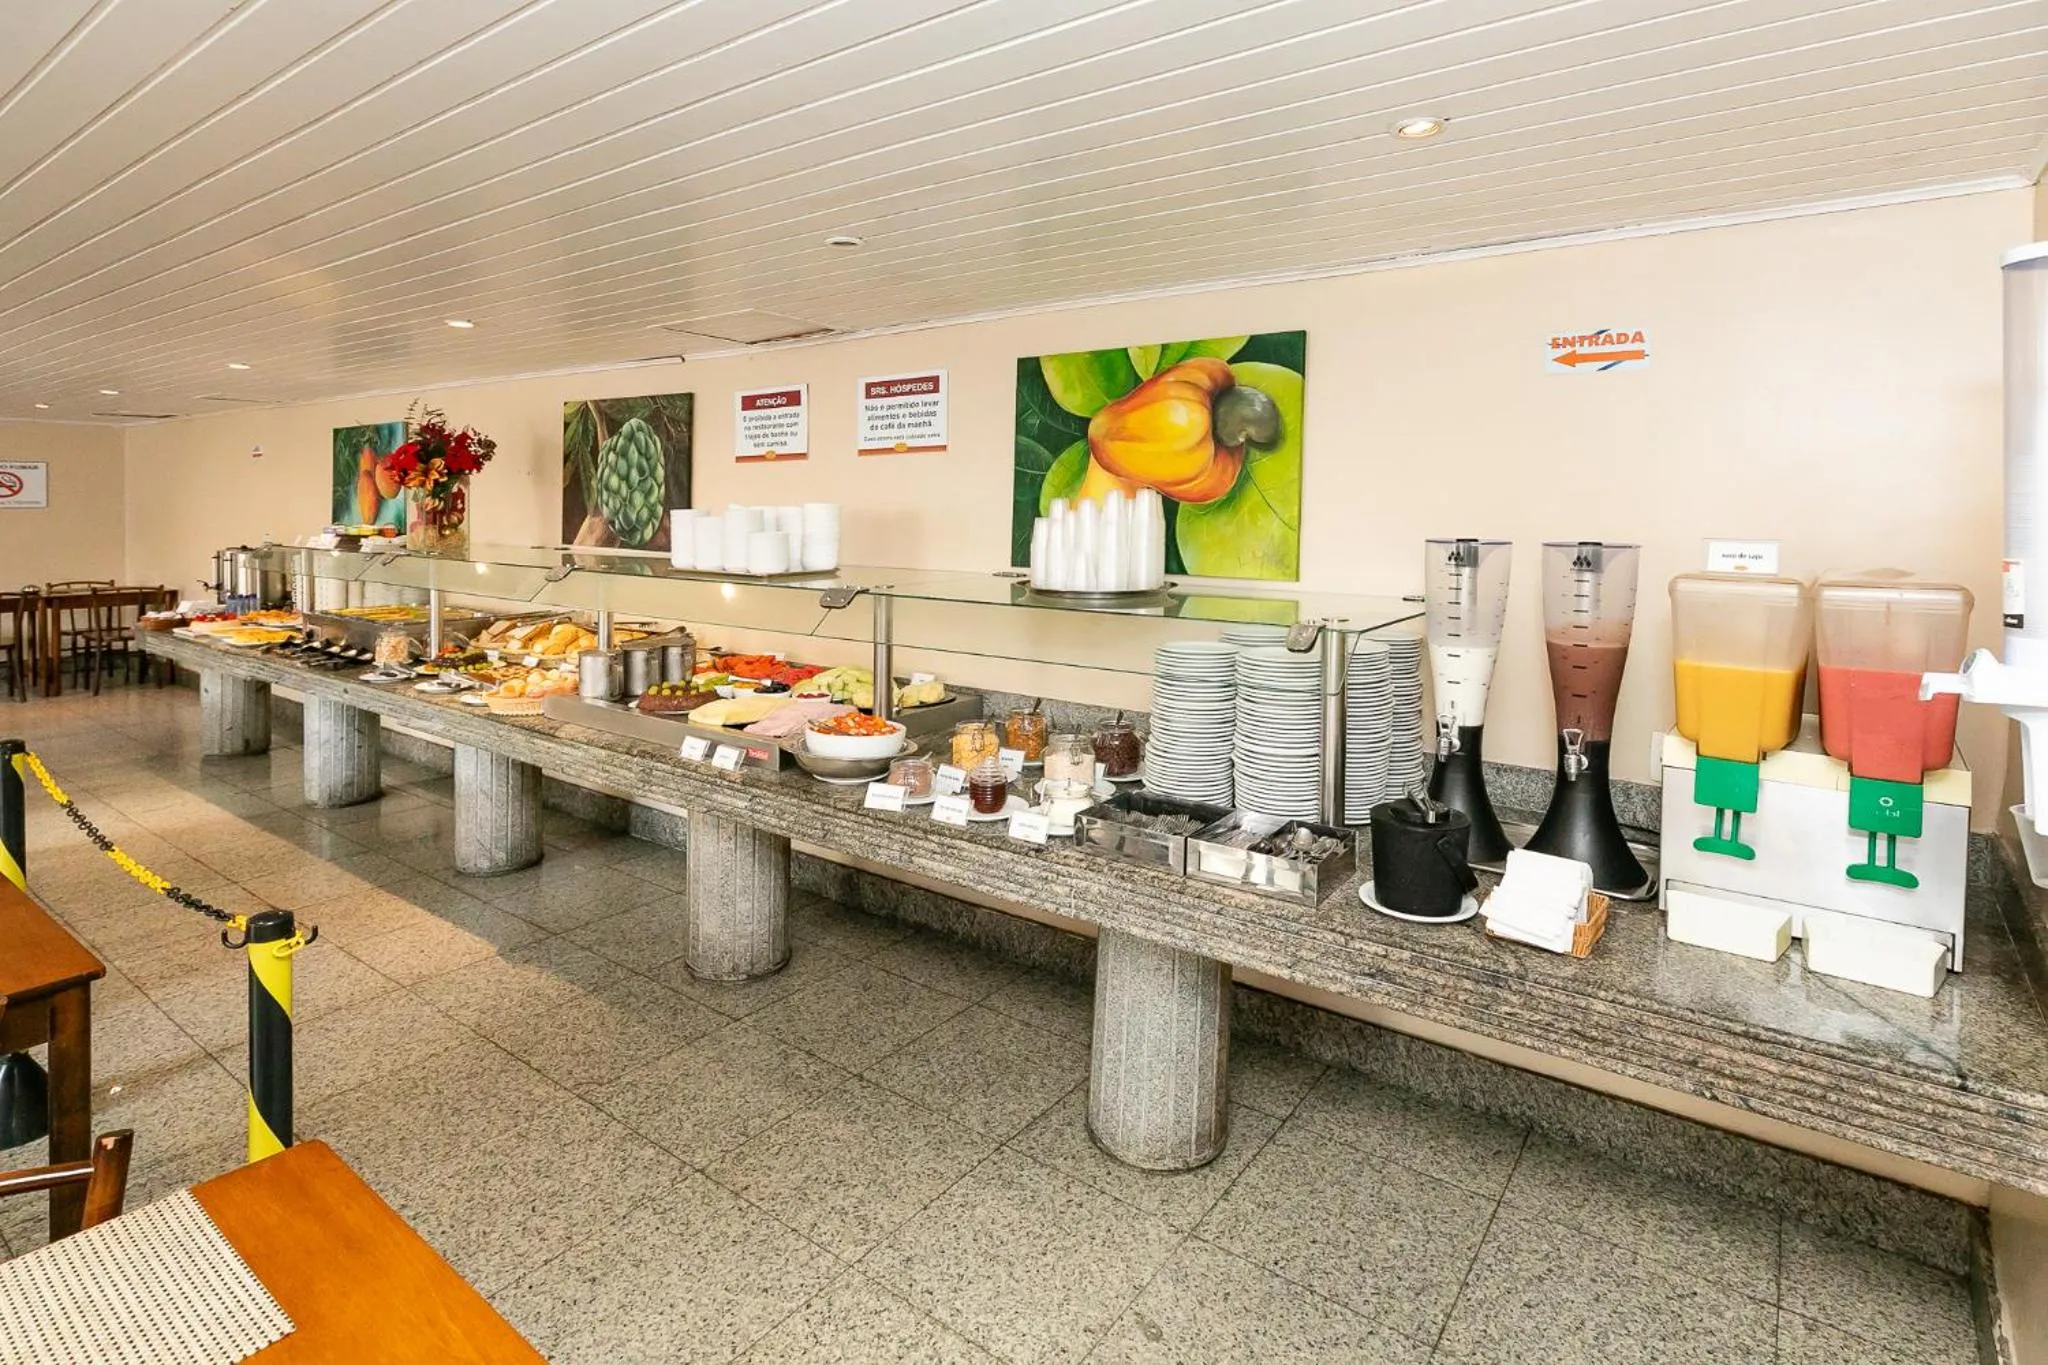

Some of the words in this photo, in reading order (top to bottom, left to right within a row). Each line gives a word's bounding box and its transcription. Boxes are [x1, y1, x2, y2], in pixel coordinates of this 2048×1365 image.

[1551, 331, 1645, 349] ENTRADA
[890, 382, 934, 393] HÓSPEDES
[756, 396, 787, 407] ATENÇÃO
[886, 401, 919, 411] permitido
[867, 413, 900, 421] alimentos
[908, 410, 937, 418] bebidas
